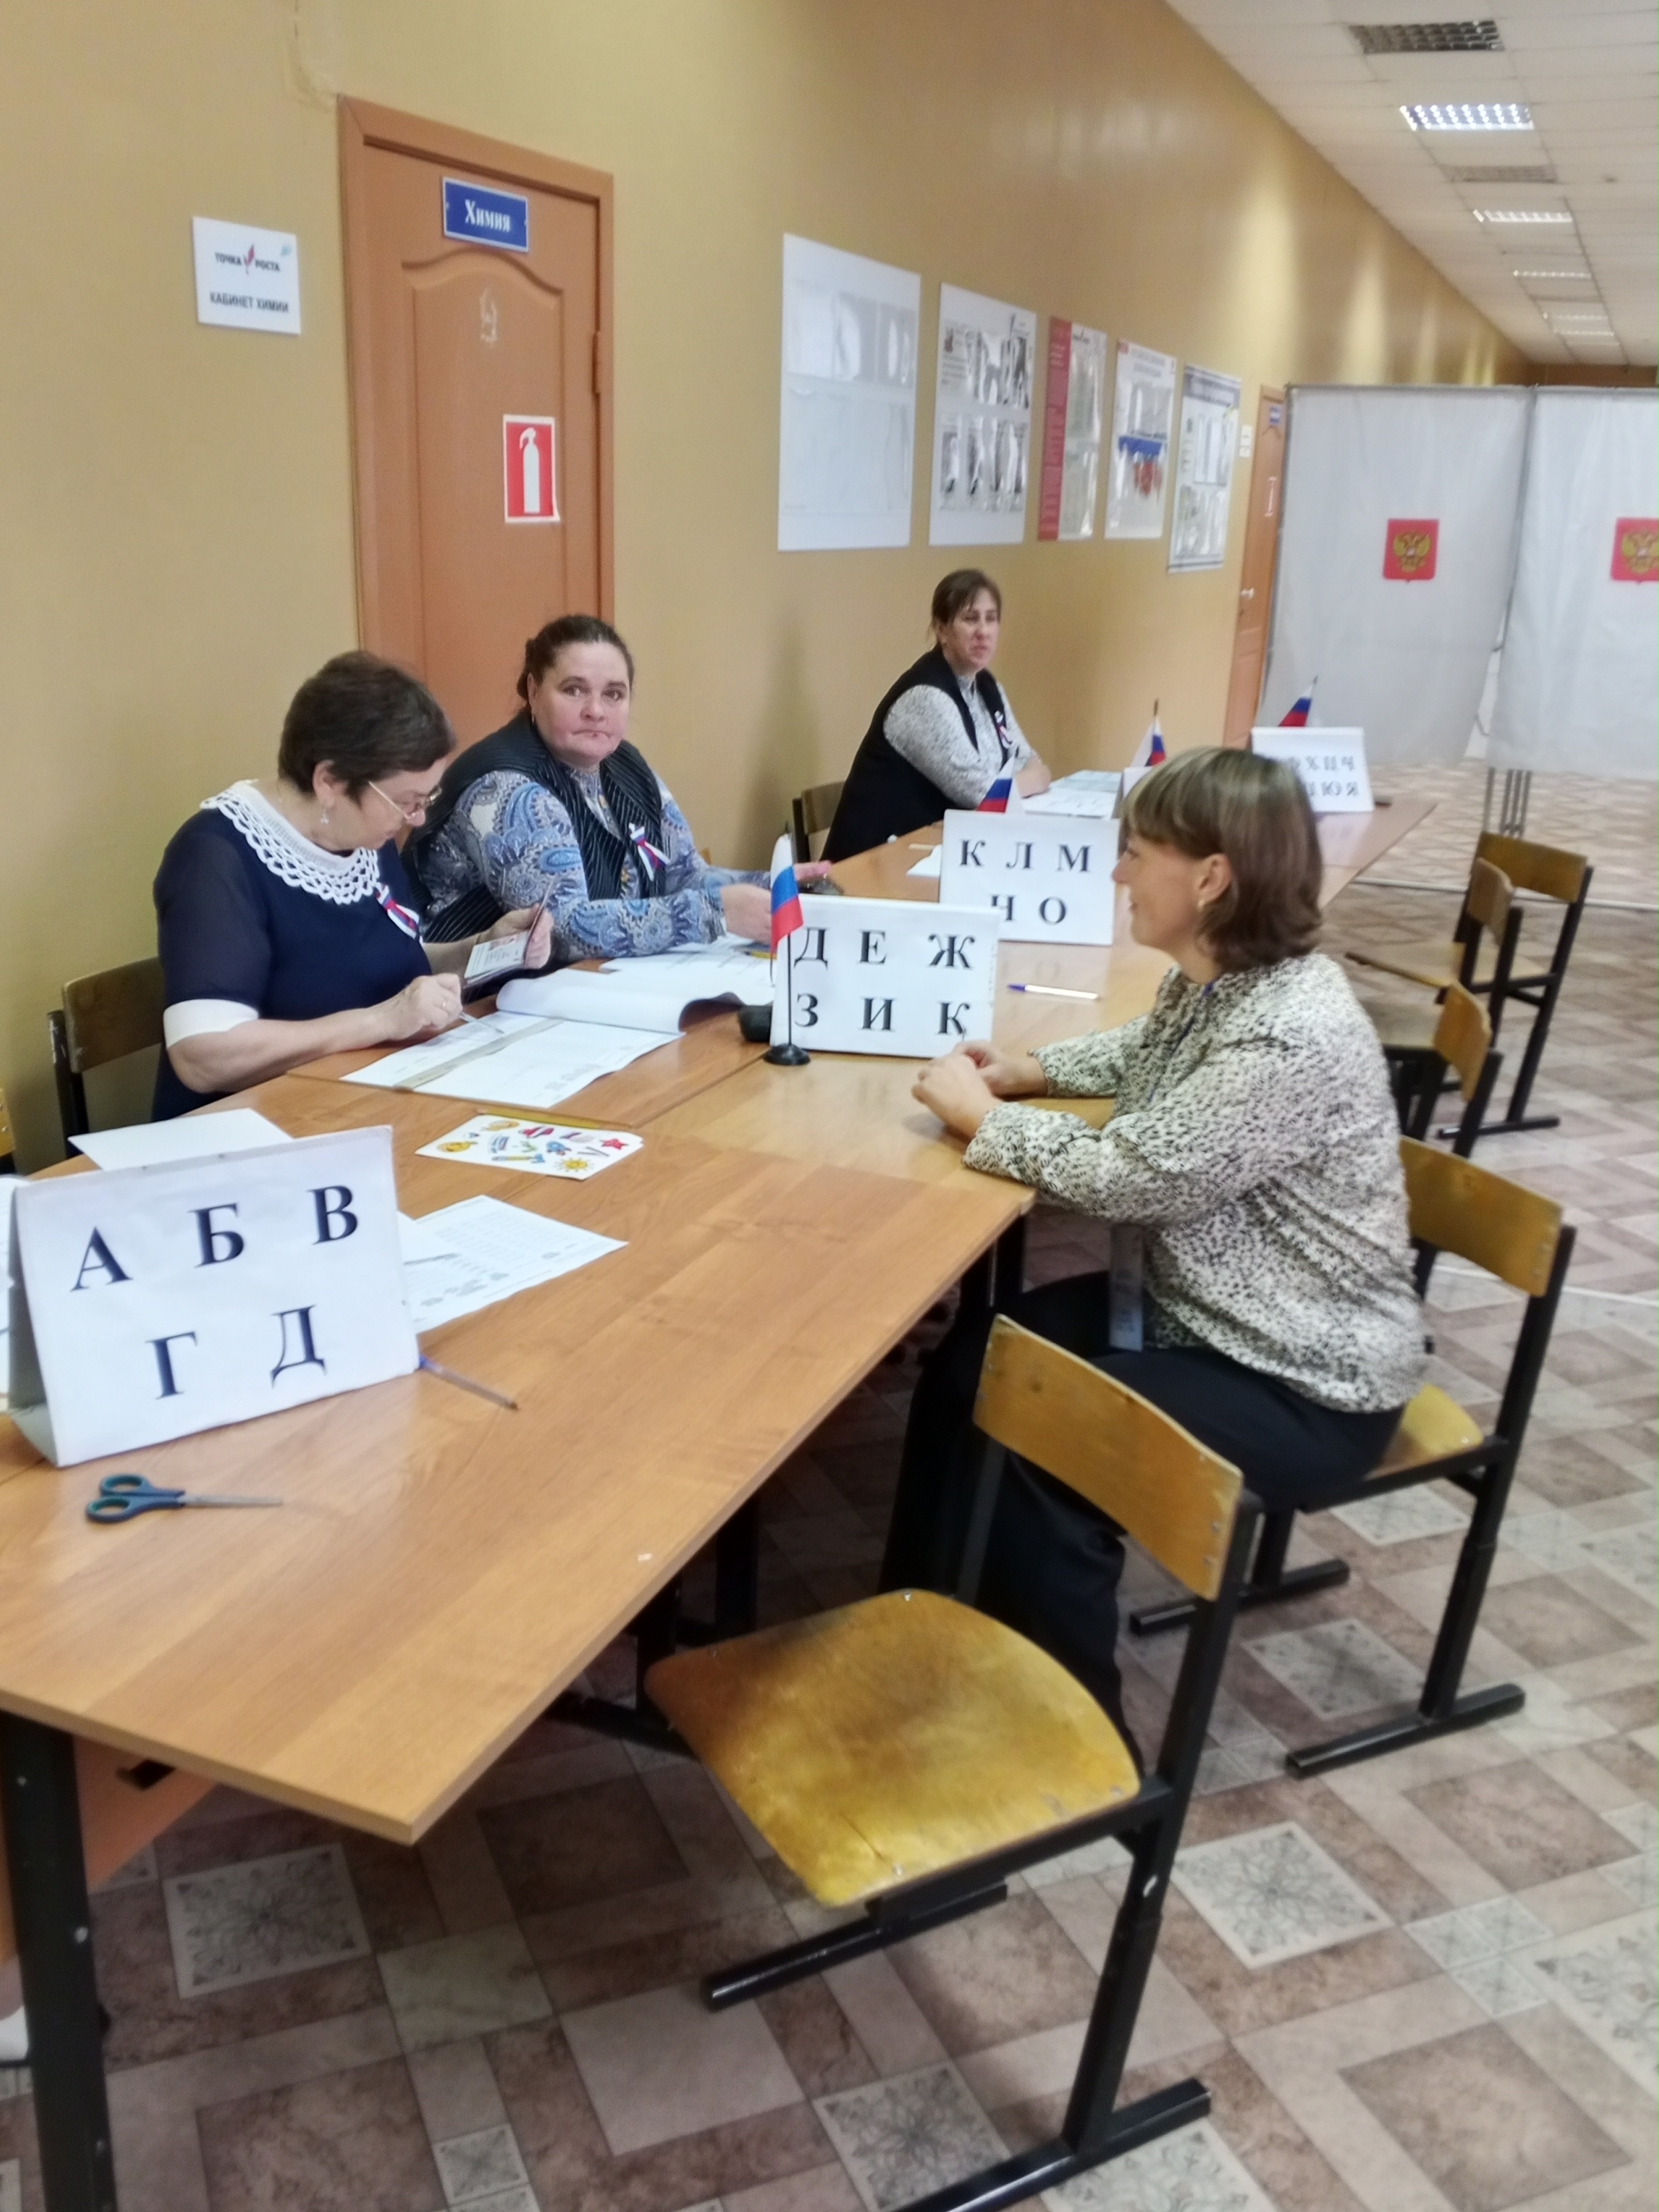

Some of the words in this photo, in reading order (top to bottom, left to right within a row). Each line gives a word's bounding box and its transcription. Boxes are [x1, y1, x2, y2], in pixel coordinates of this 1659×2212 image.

[465, 199, 511, 233] Химия
[215, 252, 242, 266] ТОЧКА
[255, 258, 280, 272] РОСТА
[210, 291, 254, 309] КАБИНЕТ
[256, 297, 289, 314] ХИМИИ
[960, 839, 986, 867] К
[1005, 841, 1035, 870] Л
[1056, 844, 1092, 872] М
[1039, 896, 1067, 925] О
[794, 927, 828, 970] Д
[856, 929, 887, 965] Е
[927, 933, 975, 970] Ж
[794, 993, 819, 1028] З
[858, 996, 898, 1033] И
[935, 1000, 971, 1035] К
[70, 1226, 134, 1293] А
[187, 1202, 246, 1268] Б
[306, 1185, 359, 1245] В
[145, 1331, 198, 1400] Г
[269, 1304, 328, 1390] Д
